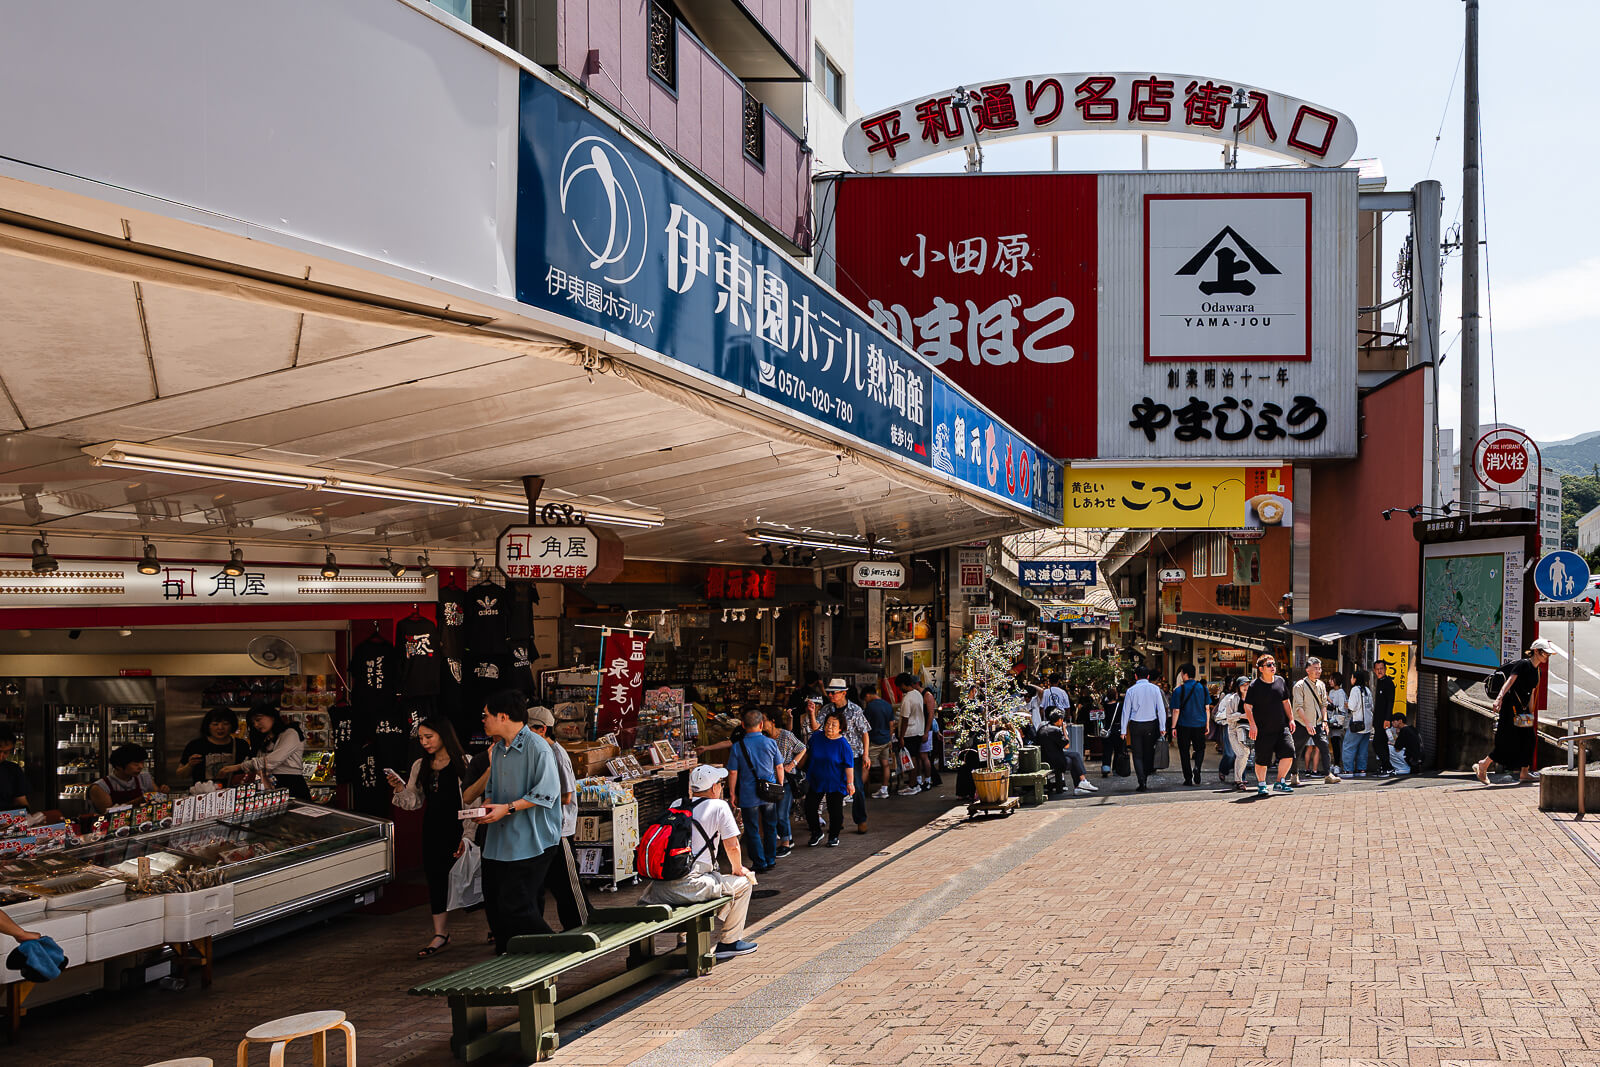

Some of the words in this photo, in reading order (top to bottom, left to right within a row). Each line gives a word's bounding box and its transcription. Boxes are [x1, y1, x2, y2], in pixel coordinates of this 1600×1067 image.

[860, 75, 1338, 159] 平和通り名店街入口
[899, 233, 1034, 279] 小田原
[545, 264, 655, 333] 伊東園ホテルズ
[1201, 302, 1255, 313] Odawara
[665, 203, 924, 427] 伊東園ホテル熱海館
[1184, 317, 1271, 327] YAMA-JOU
[1167, 366, 1289, 388] 創業明治十一年
[778, 372, 853, 424] 0570-020-780
[1129, 396, 1327, 442] やまじょう
[890, 424, 914, 451] 徒歩1分
[1487, 452, 1525, 470] 消火栓
[1071, 481, 1104, 494] 黄色い
[1121, 480, 1203, 511] こっこ
[1073, 497, 1116, 509] しあわせ
[540, 535, 588, 558] 角屋
[507, 565, 587, 578] 平和通り名店街
[1024, 569, 1050, 581] 熱海
[1065, 569, 1092, 581] 温泉
[207, 570, 269, 597] 角屋
[1538, 606, 1588, 618] 軽車両を除く
